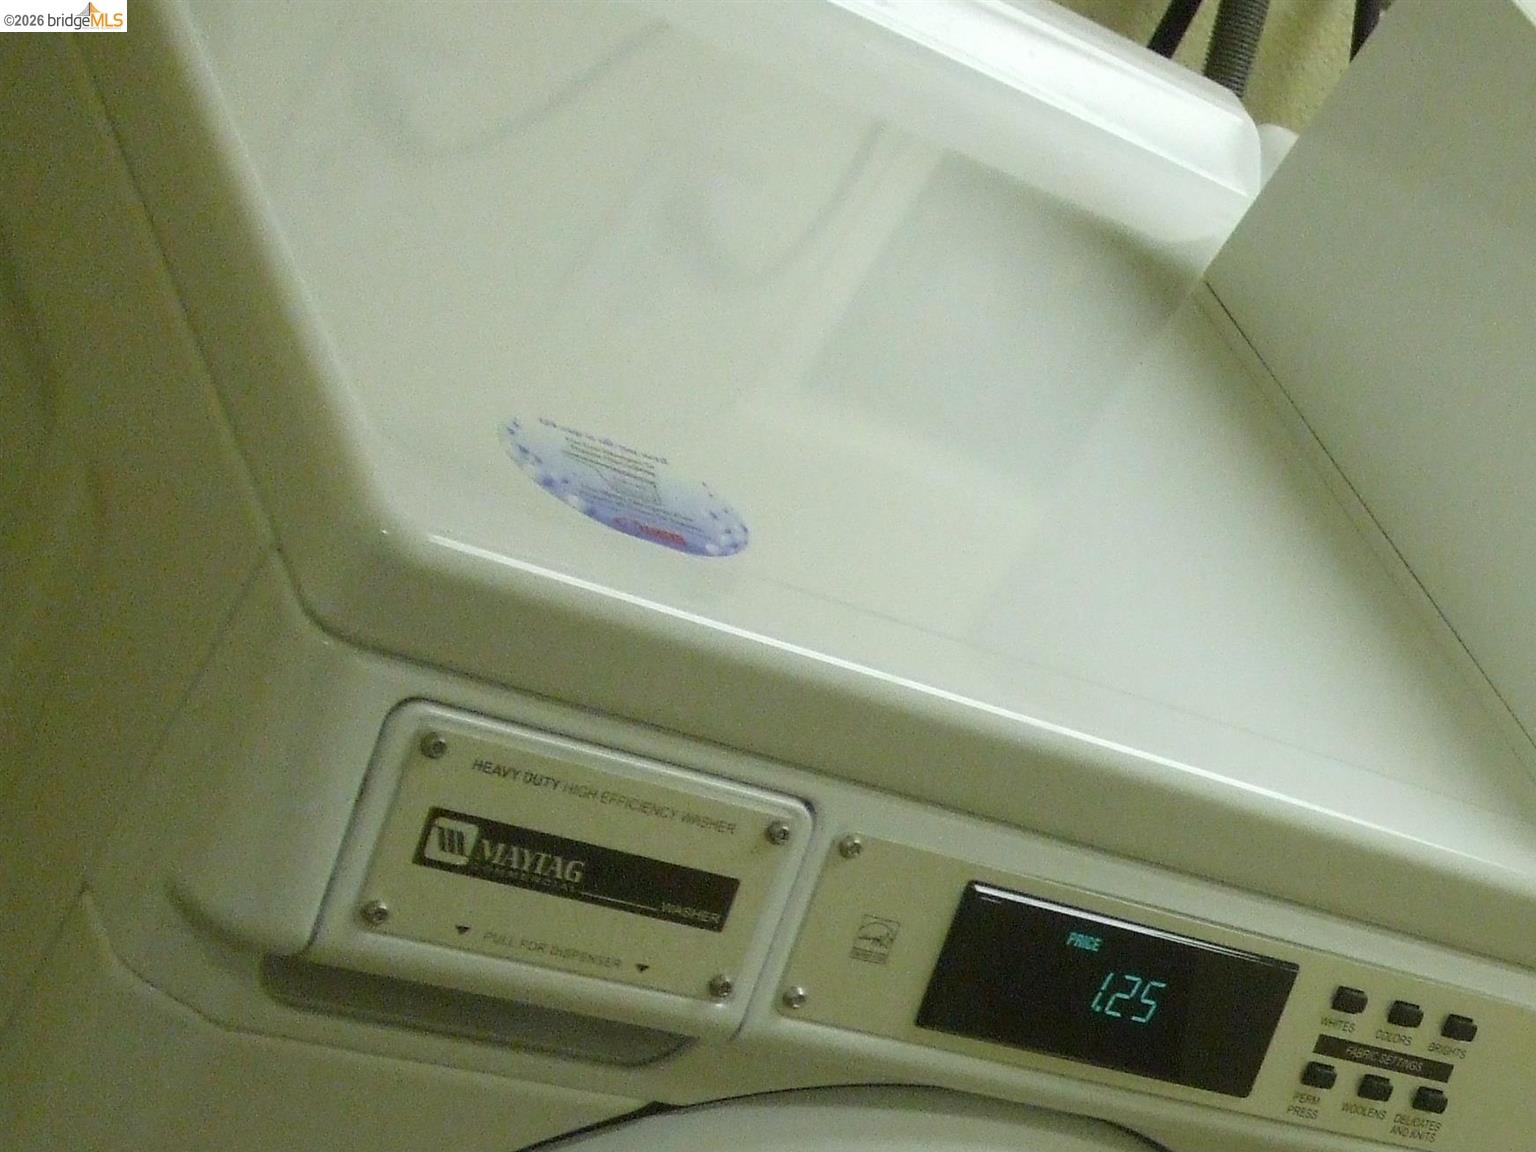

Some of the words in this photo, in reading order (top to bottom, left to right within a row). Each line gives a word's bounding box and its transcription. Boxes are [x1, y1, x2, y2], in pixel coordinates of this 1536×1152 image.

[472, 759, 520, 784] HEAVY
[523, 771, 561, 791] DUTY
[479, 839, 586, 884] MAYTAG
[1320, 1016, 1357, 1034] WHITES
[1375, 1029, 1413, 1046] COLORS
[1346, 1047, 1379, 1062] FABRIC
[1379, 1053, 1424, 1073] SETTINGS
[1427, 1041, 1468, 1060] BRIGHTS
[1293, 1091, 1321, 1105] PERM
[1287, 1104, 1319, 1120] PRESS
[1341, 1101, 1388, 1121] WOOLENS
[1393, 1112, 1442, 1132] DELICATES
